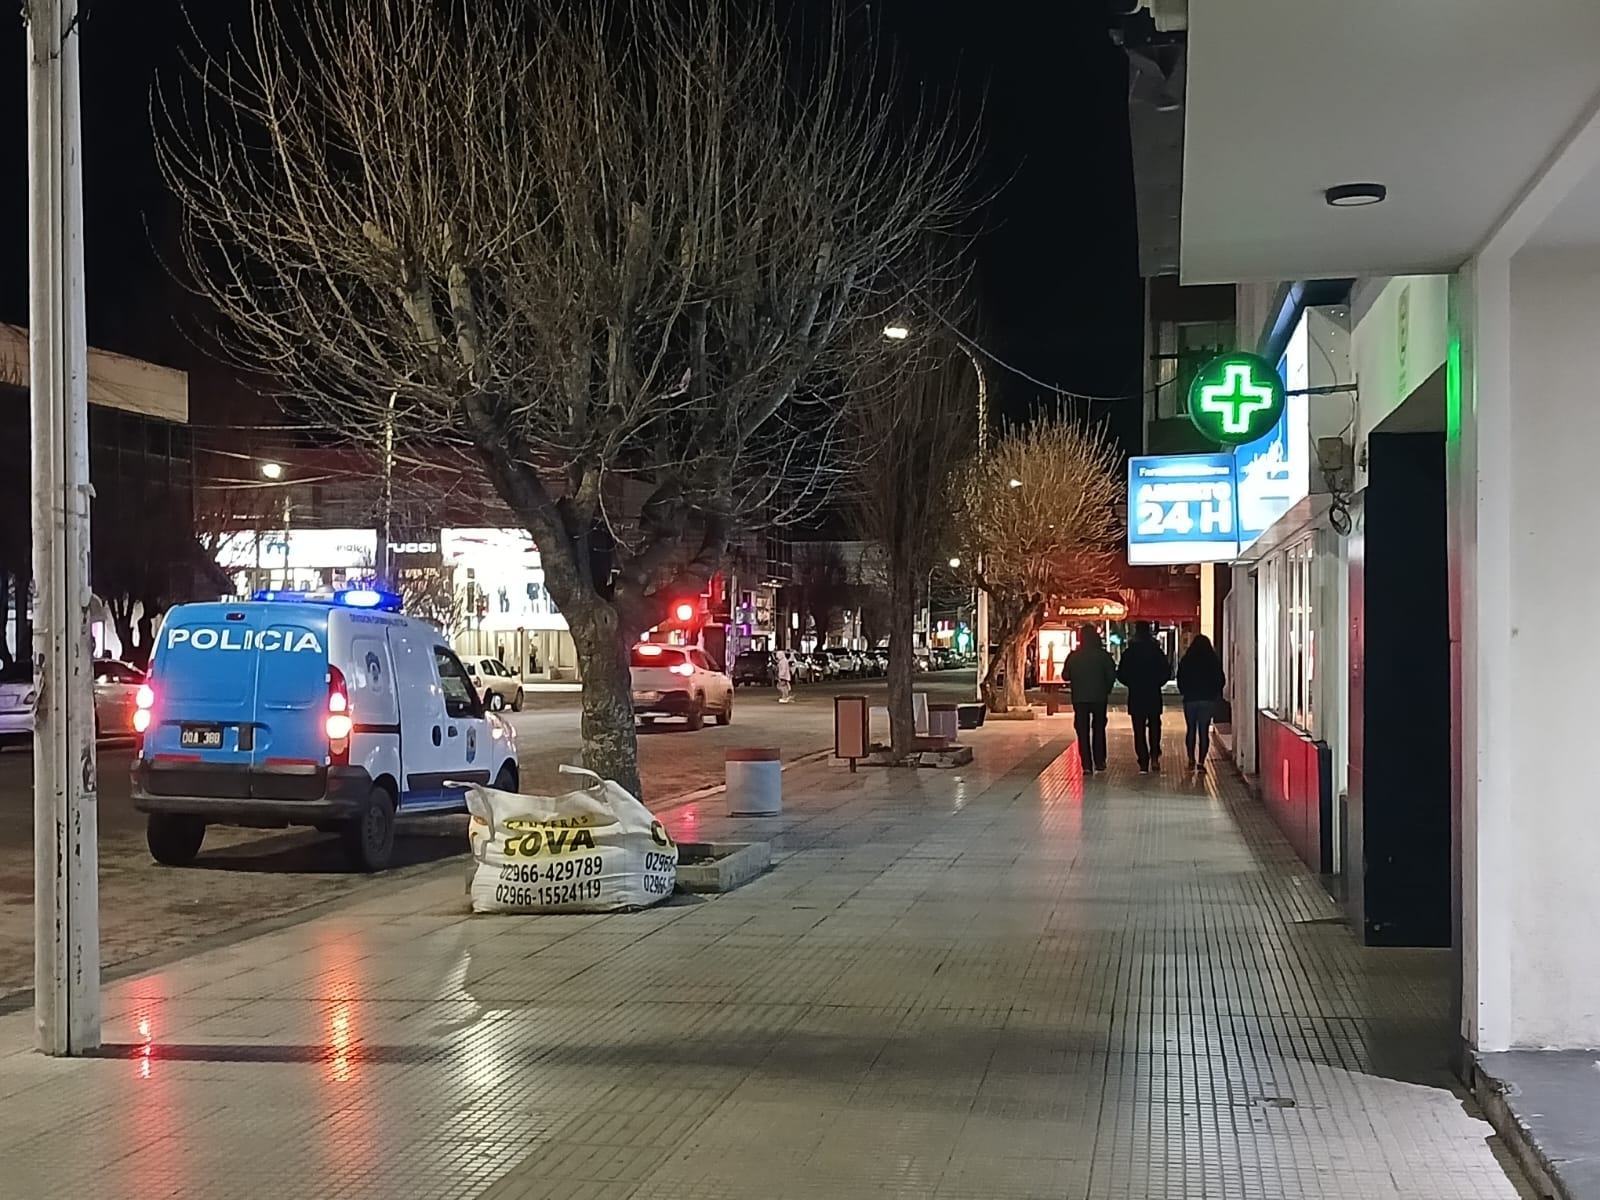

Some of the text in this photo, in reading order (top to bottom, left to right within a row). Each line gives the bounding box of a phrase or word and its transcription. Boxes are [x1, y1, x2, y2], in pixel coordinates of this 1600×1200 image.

[1136, 501, 1232, 535] 24 H
[167, 628, 323, 653] POLICIA
[499, 855, 603, 884] 02966-429789
[495, 879, 601, 906] 02966-15524119
